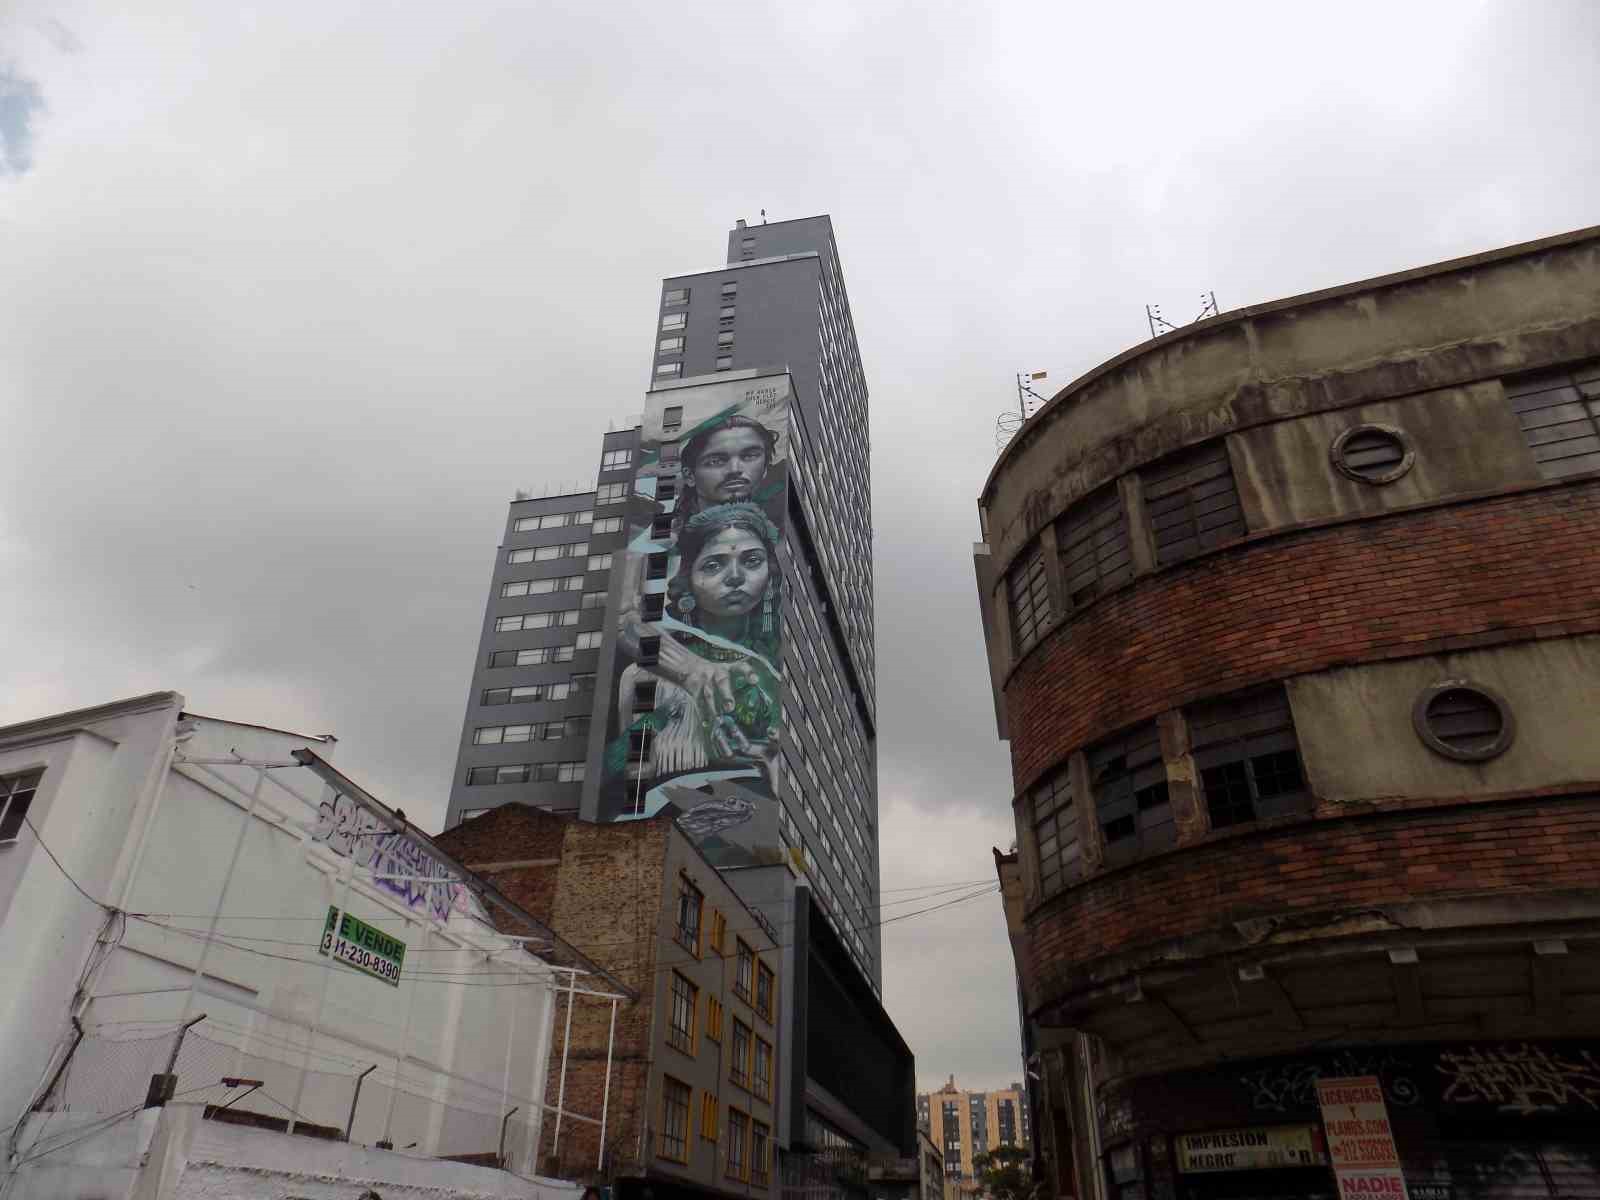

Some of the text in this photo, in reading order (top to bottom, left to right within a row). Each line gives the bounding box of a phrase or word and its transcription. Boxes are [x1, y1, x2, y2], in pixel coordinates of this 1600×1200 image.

[331, 911, 402, 960] SE VENDE
[1320, 1088, 1382, 1105] LICENCIAS
[1348, 1106, 1357, 1119] Y
[1185, 1131, 1268, 1150] IMPRESION
[1189, 1151, 1234, 1169] NEGRO
[1343, 1177, 1402, 1193] NADIE
